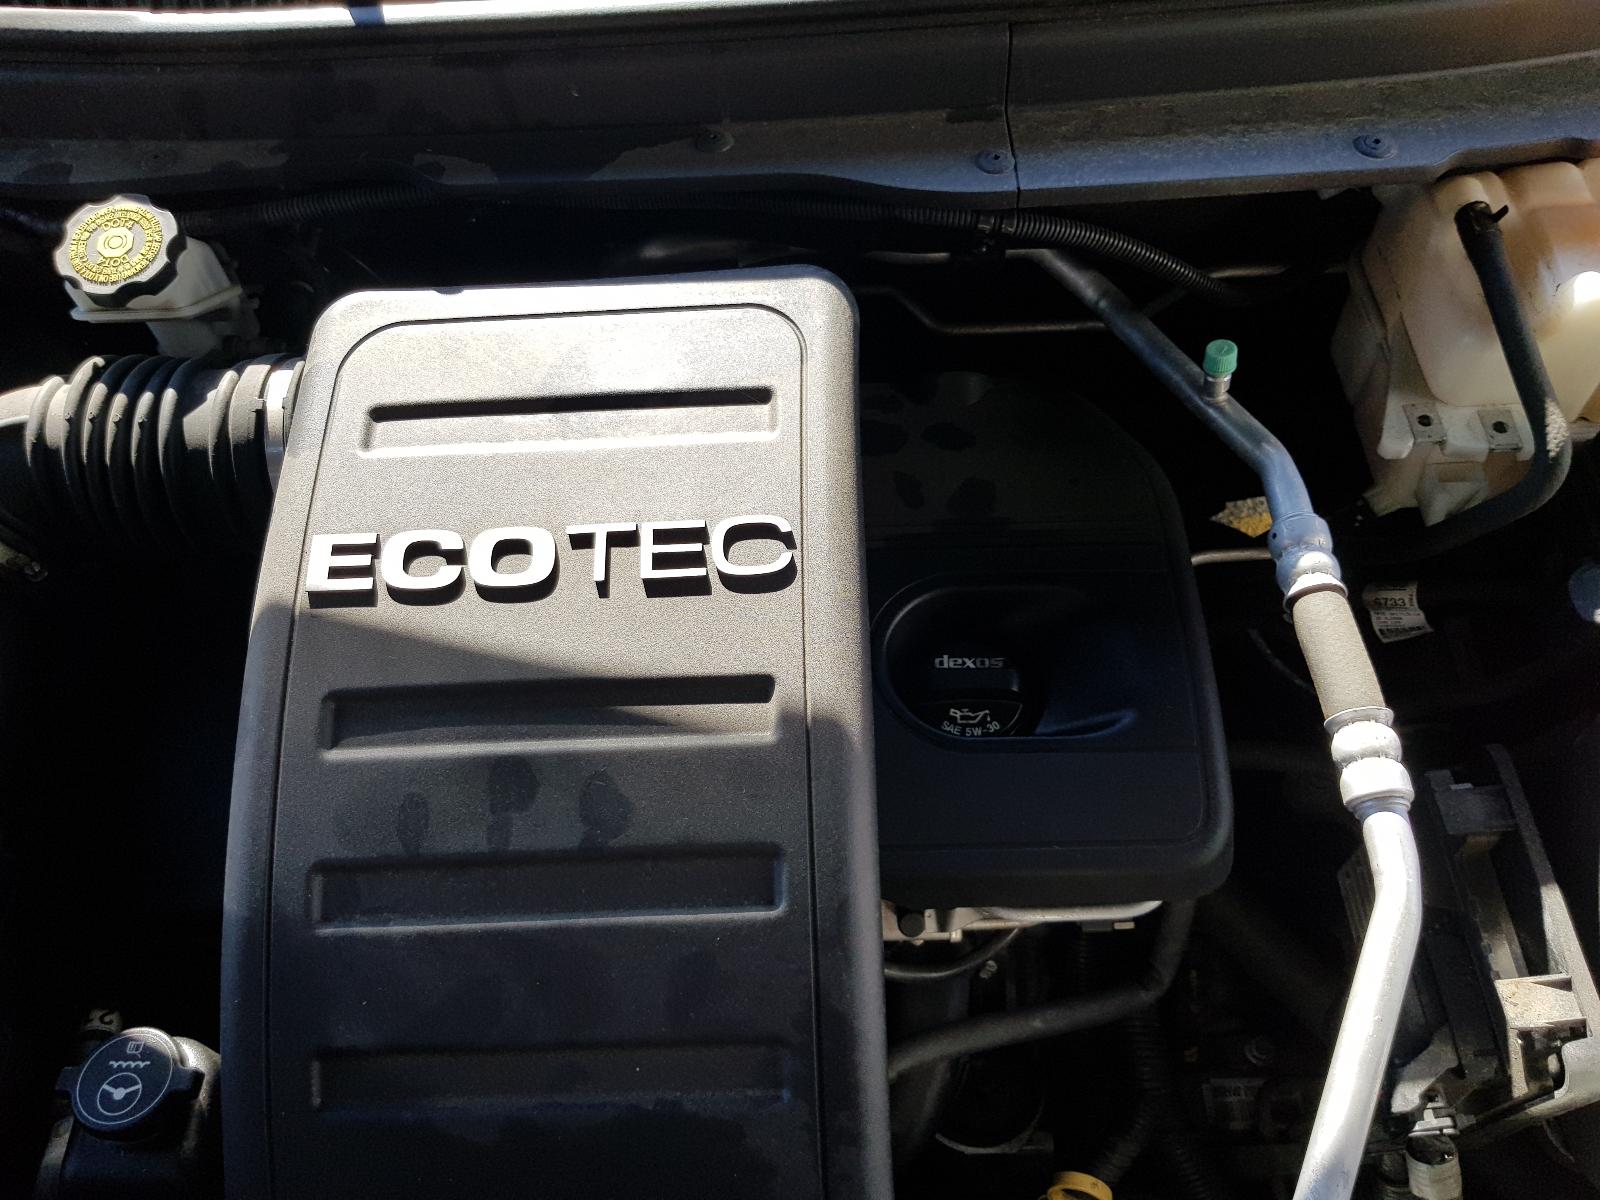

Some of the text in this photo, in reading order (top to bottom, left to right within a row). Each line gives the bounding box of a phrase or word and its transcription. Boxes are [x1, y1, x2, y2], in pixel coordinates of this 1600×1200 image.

[305, 514, 795, 593] ECOTEC
[934, 654, 1005, 669] dexos
[941, 720, 1001, 737] SAE 5W-30
